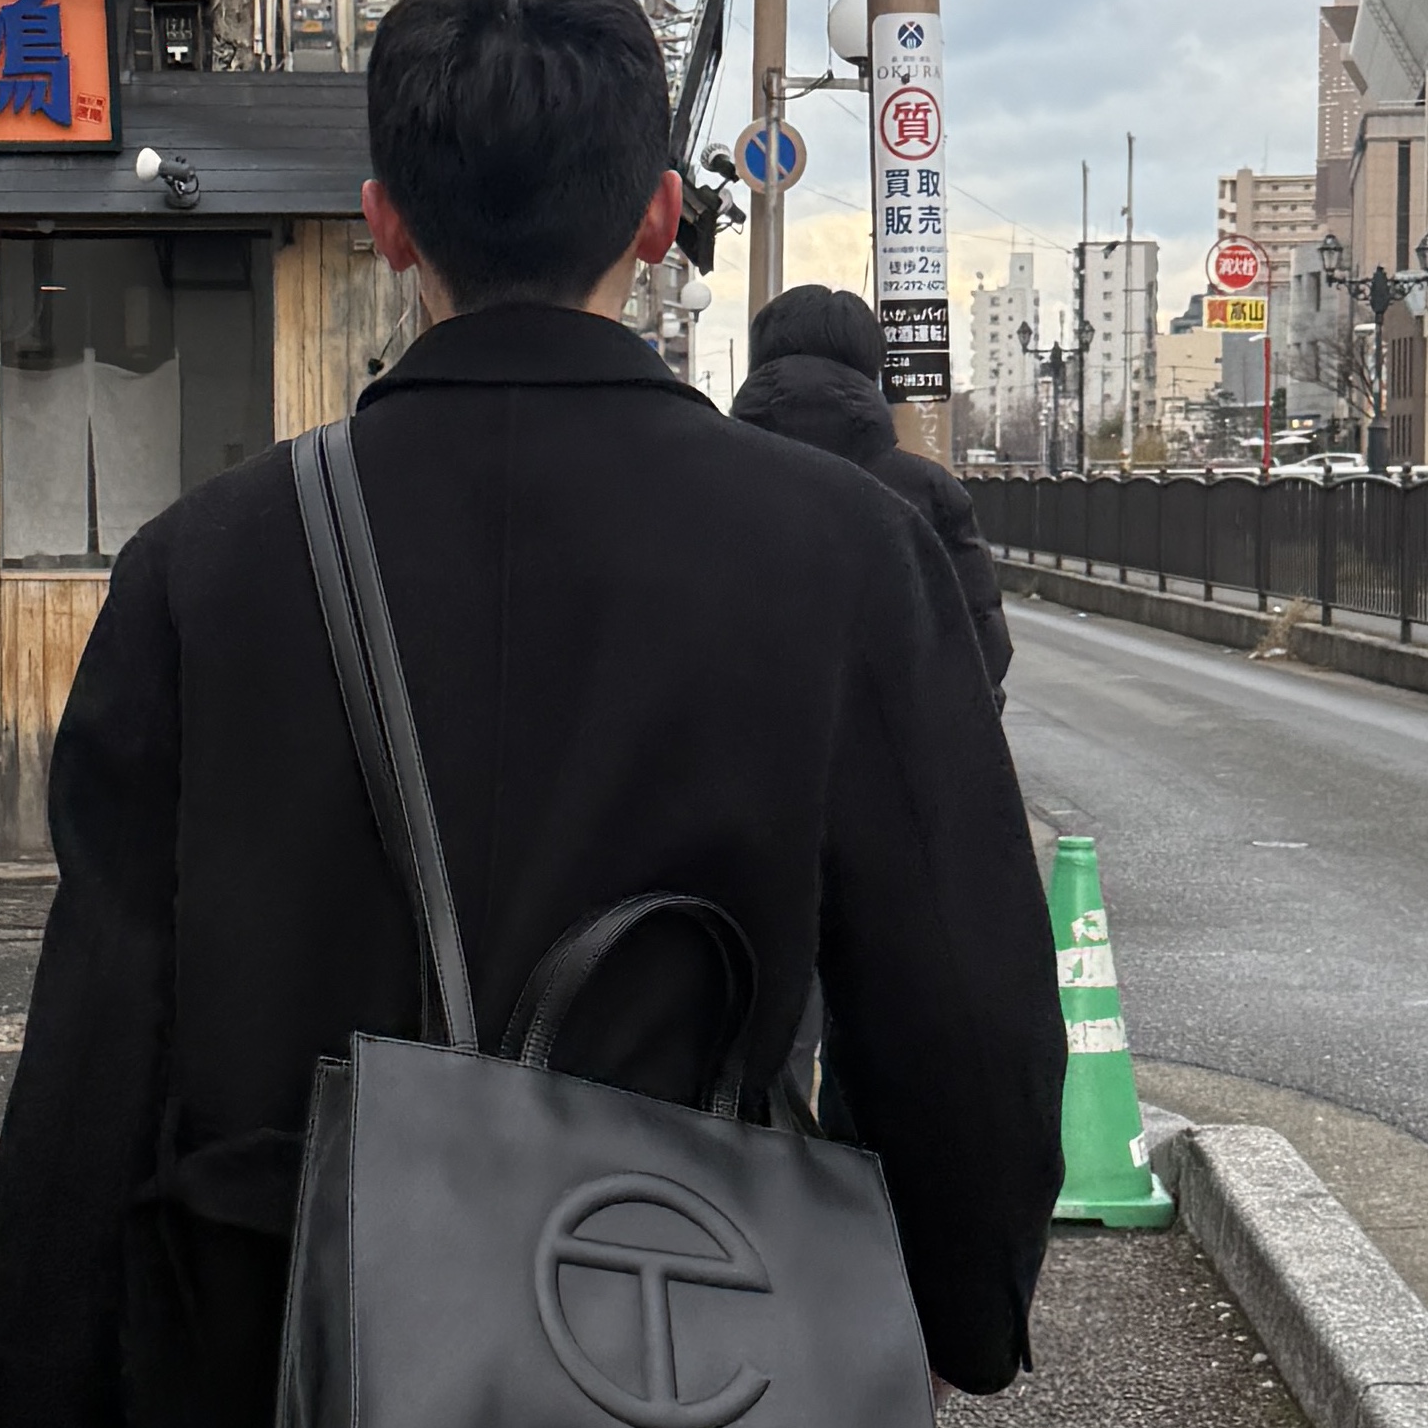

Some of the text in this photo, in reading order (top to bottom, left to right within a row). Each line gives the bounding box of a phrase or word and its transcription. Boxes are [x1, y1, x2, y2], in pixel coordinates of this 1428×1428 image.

[876, 63, 941, 81] OKURA
[892, 100, 933, 147] 質
[885, 168, 941, 199] 買取
[884, 206, 942, 236] 販売
